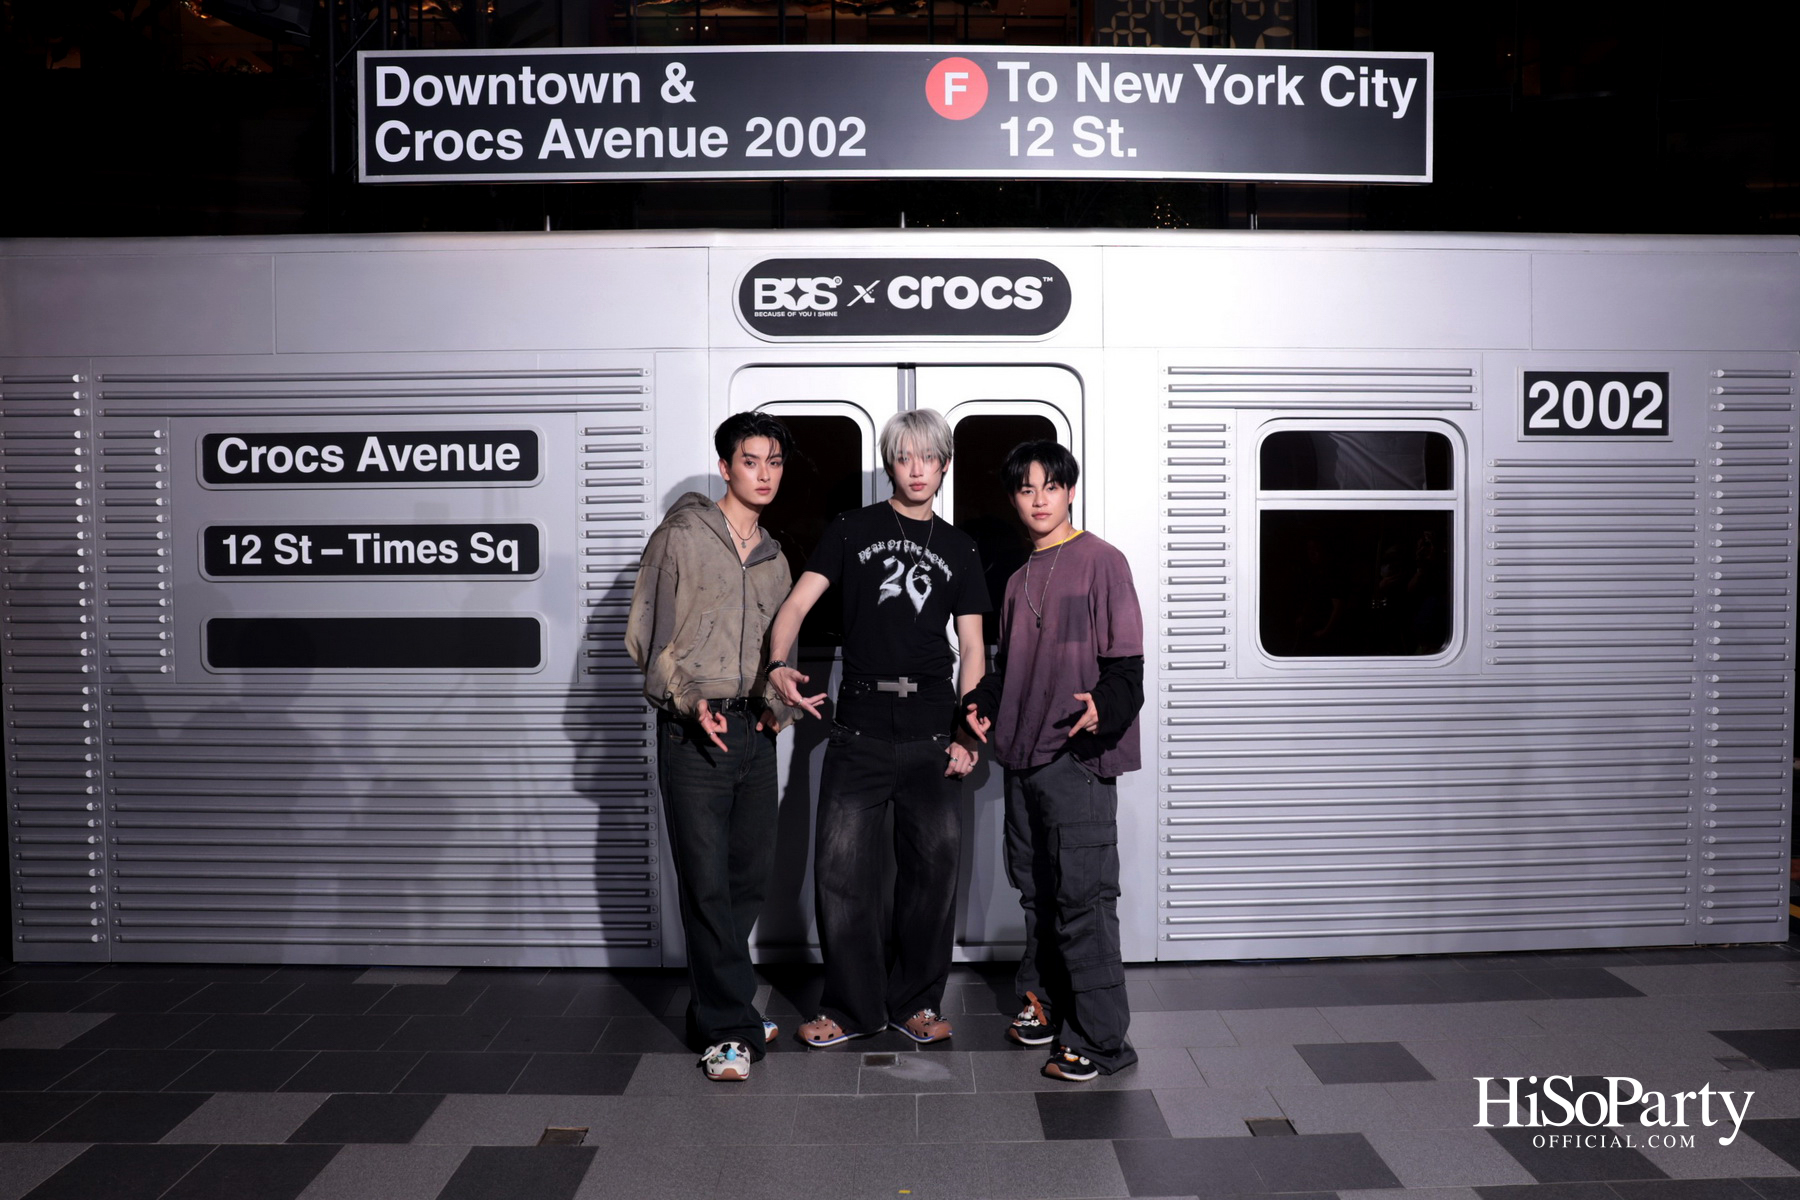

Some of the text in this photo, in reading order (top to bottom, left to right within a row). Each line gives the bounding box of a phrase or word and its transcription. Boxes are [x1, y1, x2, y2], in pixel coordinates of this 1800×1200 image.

[377, 62, 696, 106] Downtown &
[945, 72, 968, 105] F
[998, 62, 1417, 118] To New York City
[376, 117, 866, 162] Crocs Avenue 2002
[1001, 116, 1136, 157] 12 St.
[1529, 381, 1662, 429] 2002
[218, 437, 520, 474] Crocs Avenue
[223, 535, 261, 564] 12
[275, 533, 312, 564] St
[348, 533, 458, 563] Times
[471, 532, 518, 571] Sq
[877, 555, 933, 614] 26
